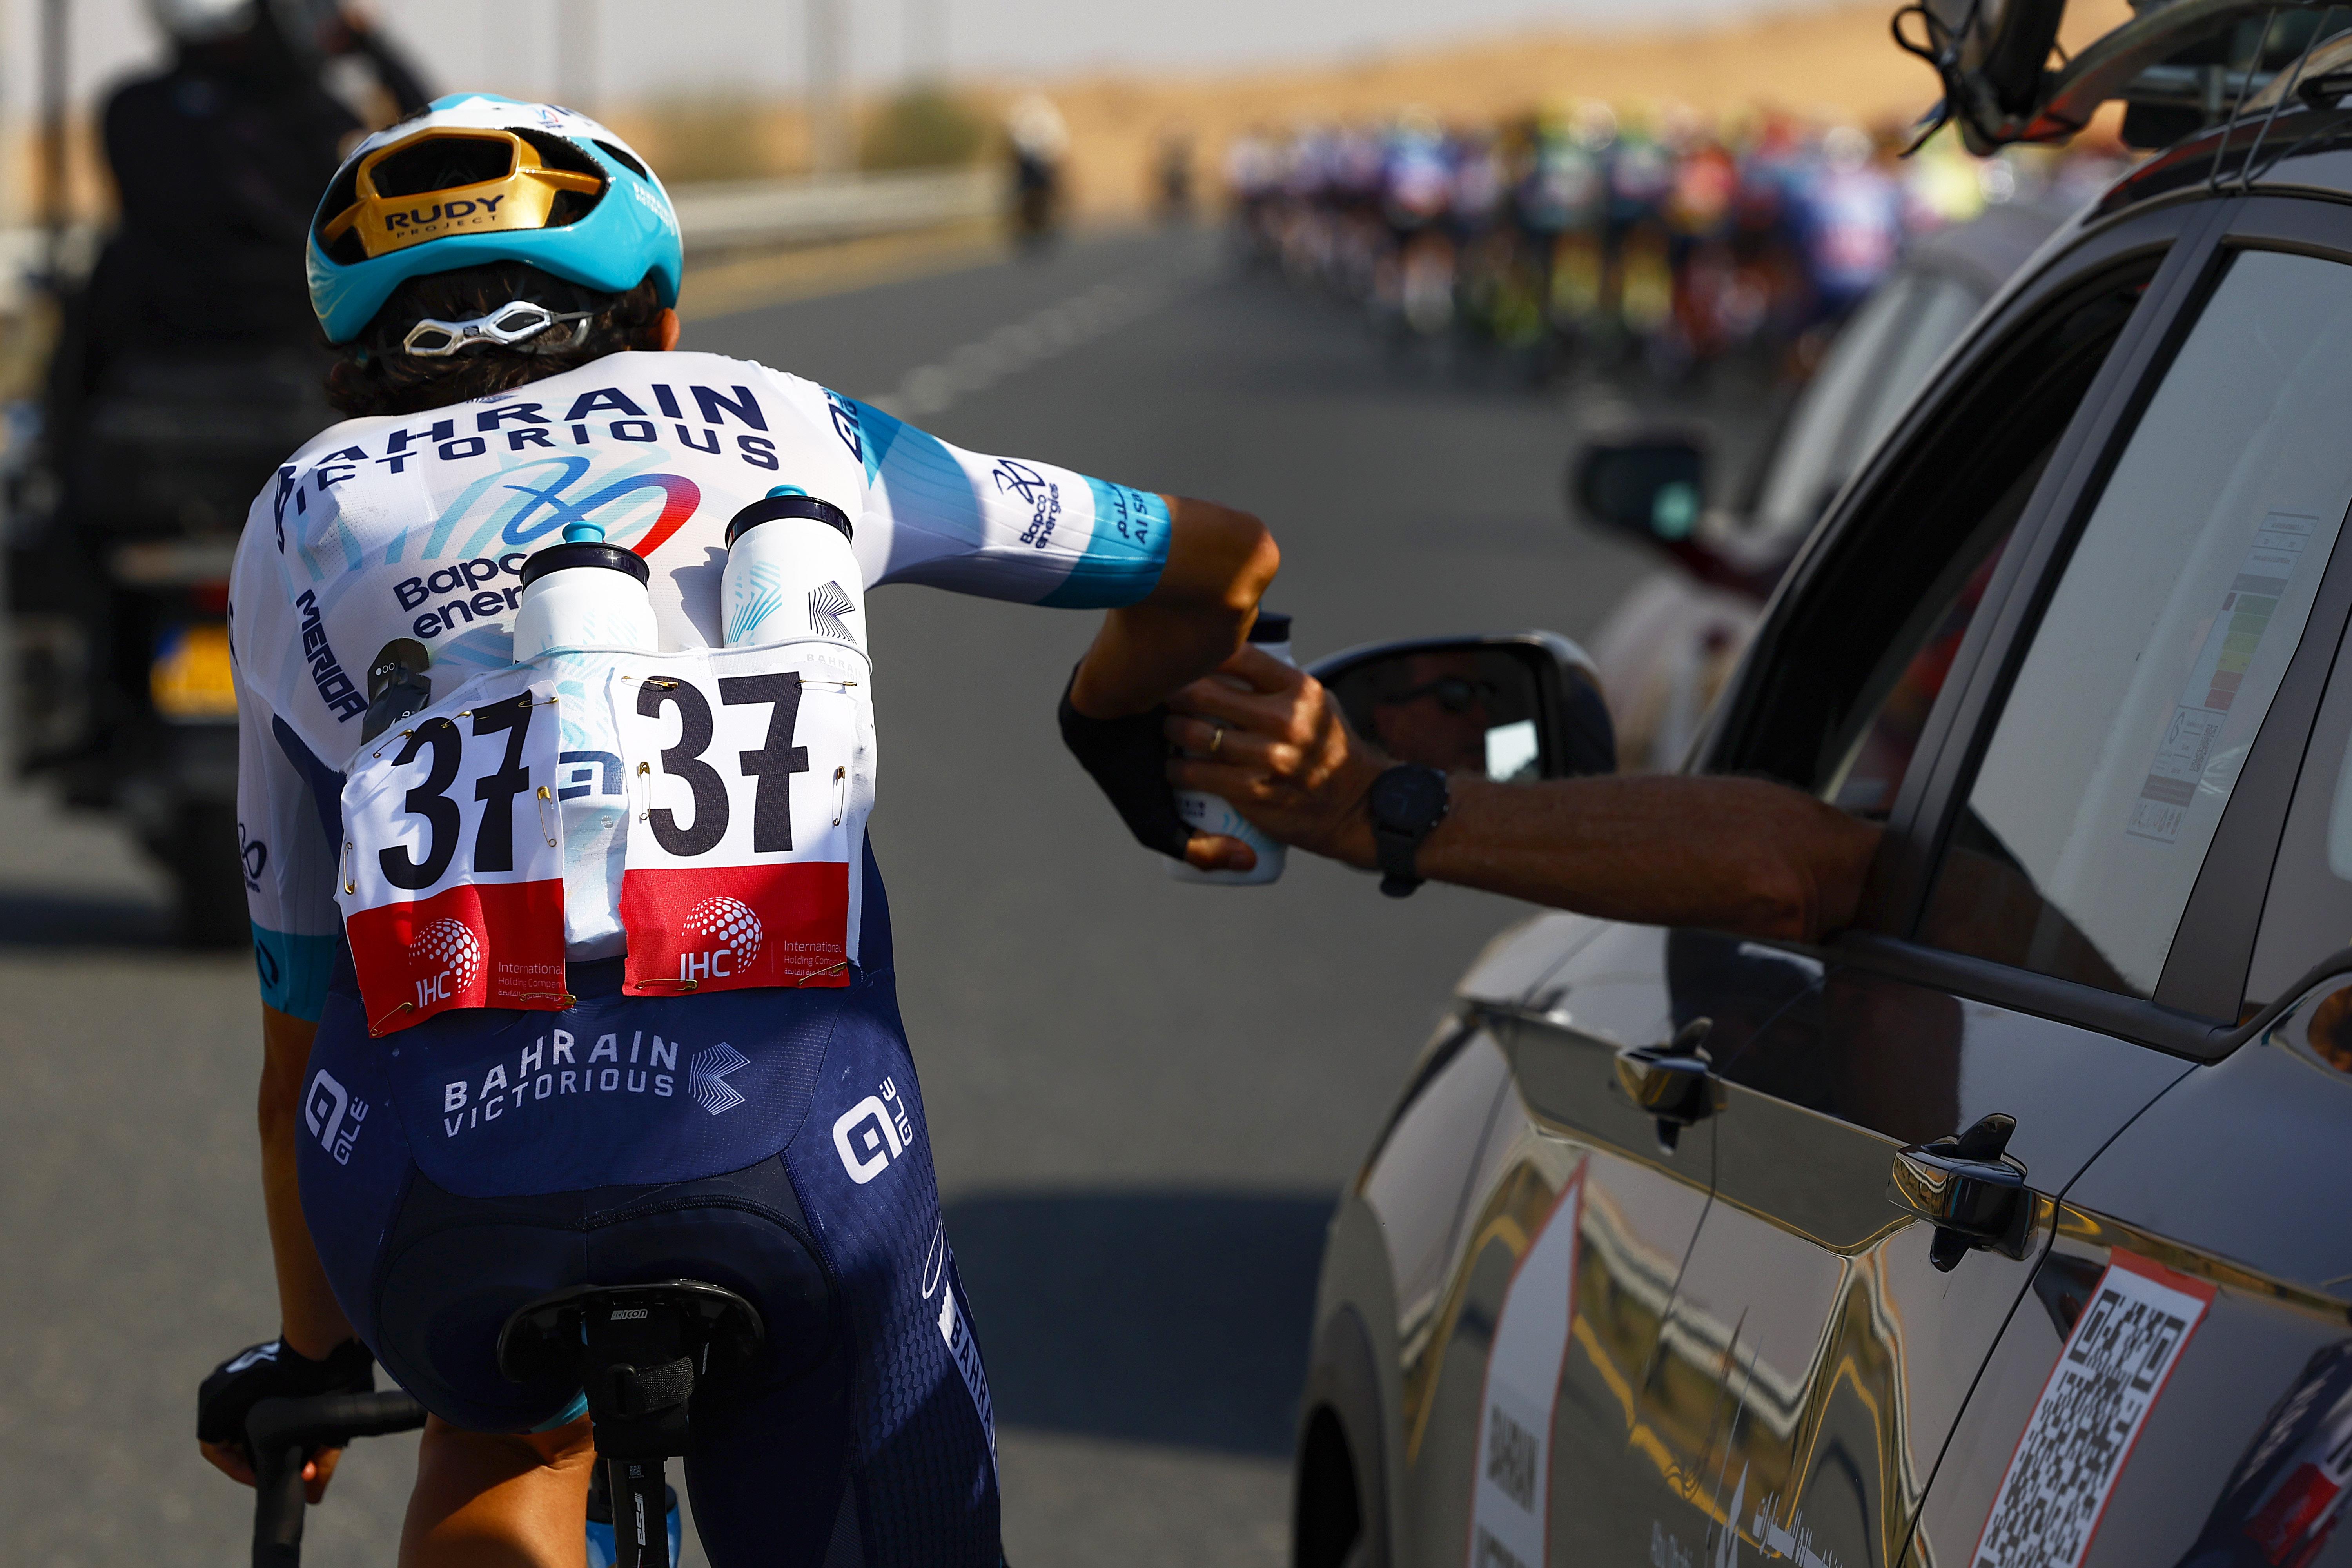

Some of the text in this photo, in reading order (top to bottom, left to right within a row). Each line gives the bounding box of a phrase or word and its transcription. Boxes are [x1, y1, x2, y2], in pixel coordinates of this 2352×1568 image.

[385, 194, 504, 230] RUDY
[397, 216, 498, 238] PROJECT
[1020, 495, 1046, 544] Bapco
[1036, 483, 1061, 549] energies
[393, 553, 528, 612] Bapc
[413, 585, 523, 639] ener
[296, 588, 369, 723] MERIDA
[637, 671, 809, 857] 37
[379, 689, 533, 890] 37
[499, 962, 563, 975] International
[680, 949, 731, 981] IHC
[784, 940, 842, 953] International
[784, 955, 813, 967] Holding
[416, 971, 451, 1009] IHC
[498, 976, 527, 990] Holding
[444, 1029, 679, 1113] BAHRAIN
[444, 1069, 674, 1138] VICTORIOUS
